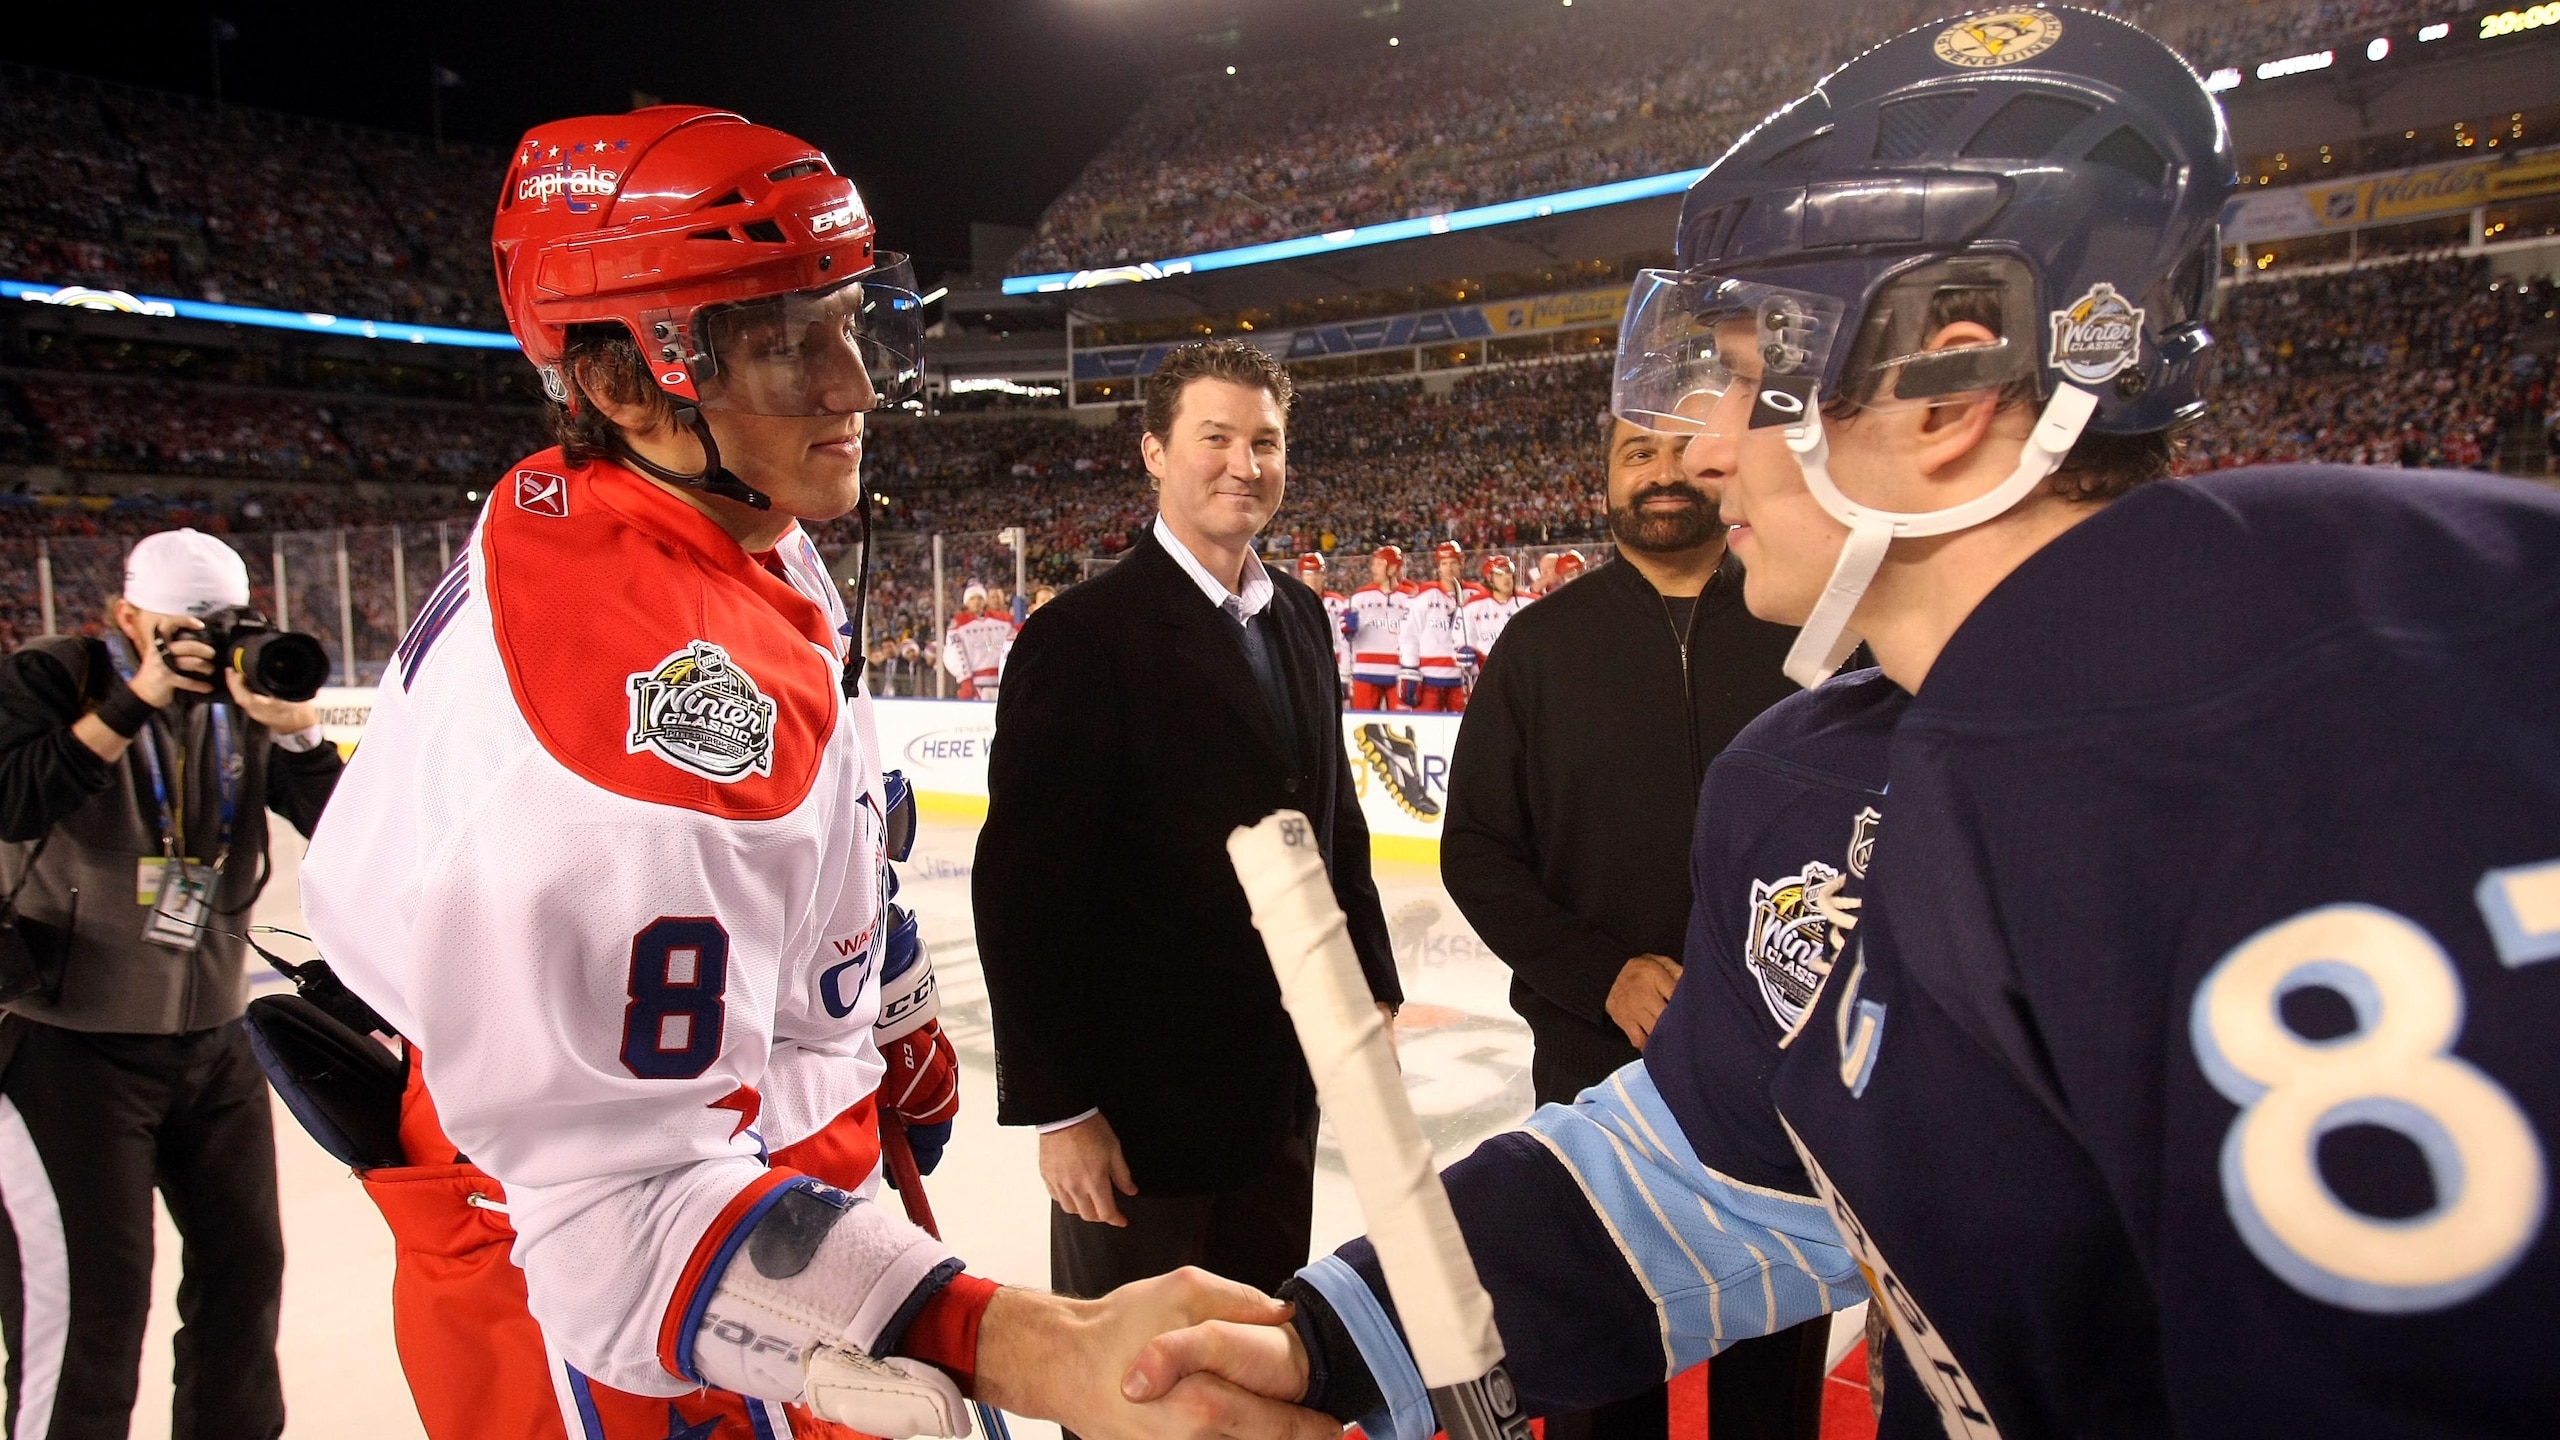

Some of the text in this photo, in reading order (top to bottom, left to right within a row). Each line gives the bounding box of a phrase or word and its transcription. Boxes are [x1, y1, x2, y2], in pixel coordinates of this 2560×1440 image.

[1942, 37, 2055, 66] PENGUINS
[2059, 316, 2131, 353] Winter
[2069, 340, 2124, 352] CLASSIC
[702, 654, 720, 668] NHL
[641, 677, 764, 733] Winter
[661, 712, 751, 743] CLASSIC
[922, 739, 976, 759] HERE
[1279, 818, 1306, 848] 87
[1765, 945, 1818, 989] CLASS
[619, 915, 730, 1079] 8
